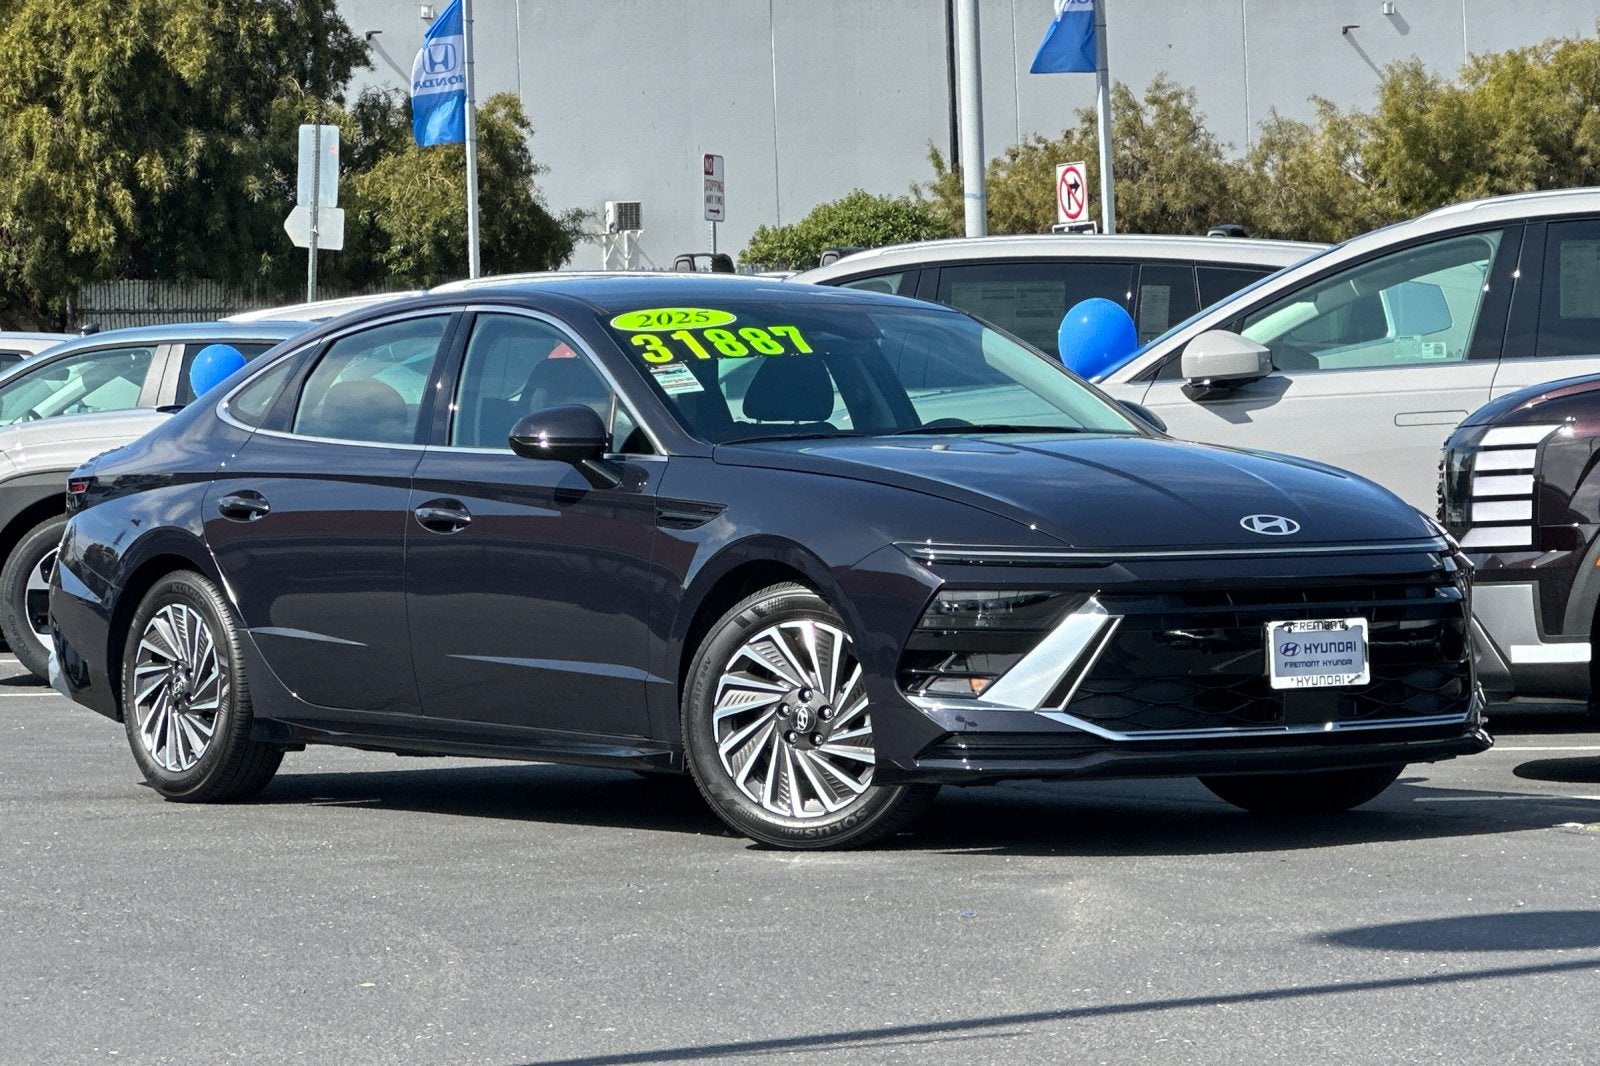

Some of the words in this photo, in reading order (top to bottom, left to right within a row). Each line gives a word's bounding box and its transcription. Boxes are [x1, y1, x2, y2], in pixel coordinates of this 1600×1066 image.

[704, 157, 713, 173] NO
[636, 310, 711, 328] 2025
[630, 325, 814, 363] 31887
[1304, 641, 1357, 655] HYUNDAI
[1284, 660, 1320, 669] FREMONT
[1323, 659, 1353, 667] HYUNDAI
[1296, 675, 1345, 687] HYUNDAI
[804, 806, 869, 838] SOLUS
